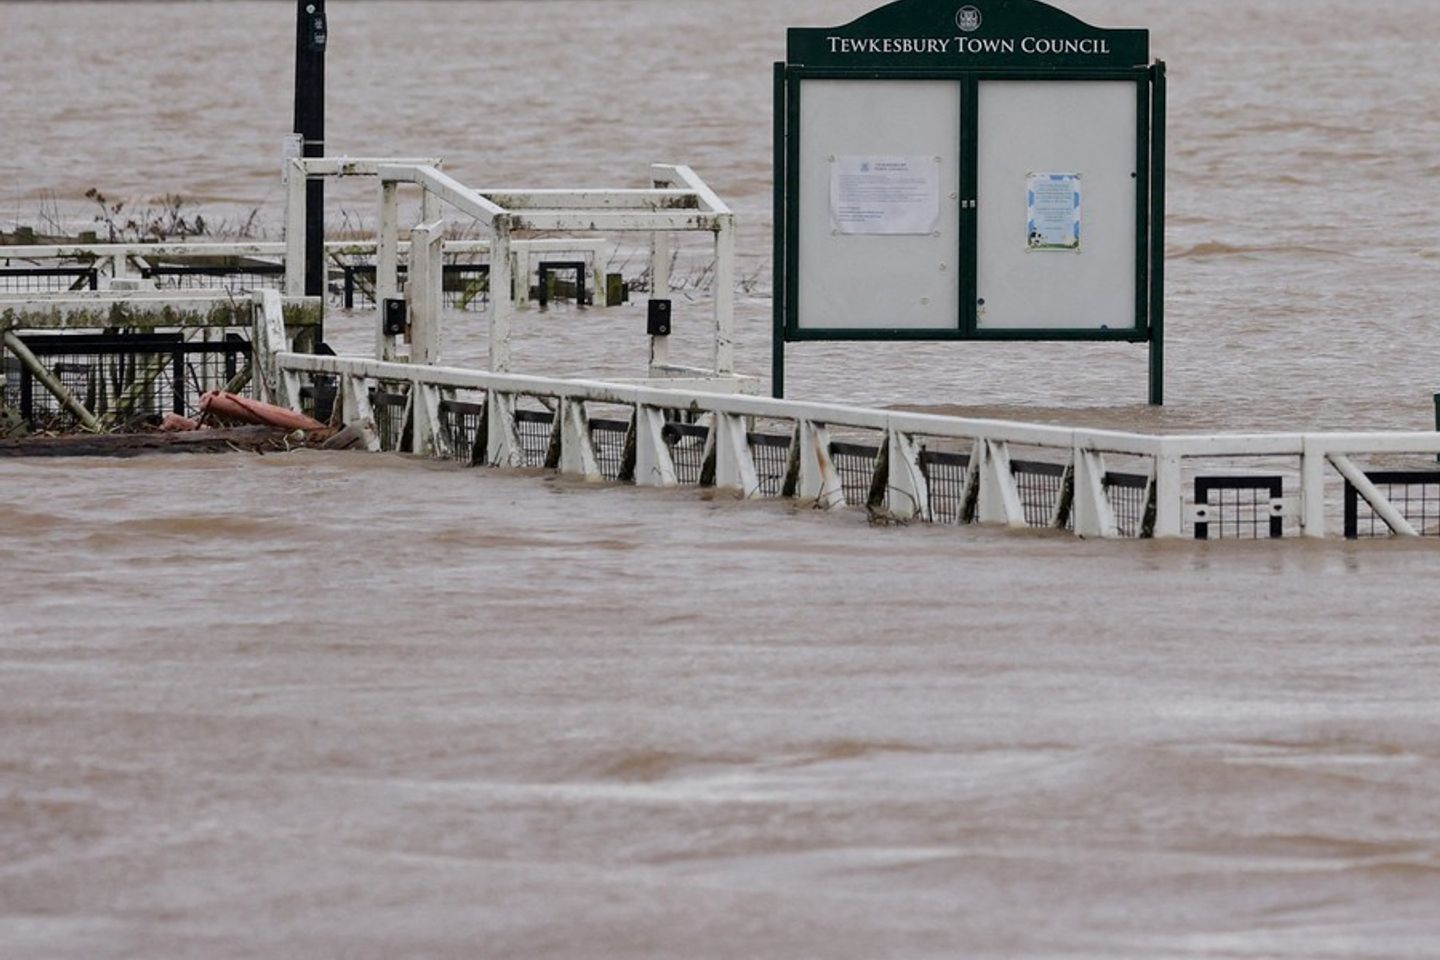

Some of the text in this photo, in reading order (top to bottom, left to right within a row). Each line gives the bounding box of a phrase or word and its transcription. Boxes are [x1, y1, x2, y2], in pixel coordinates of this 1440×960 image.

[826, 35, 1110, 54] TEWKESBURY TOWN COUNCIL
